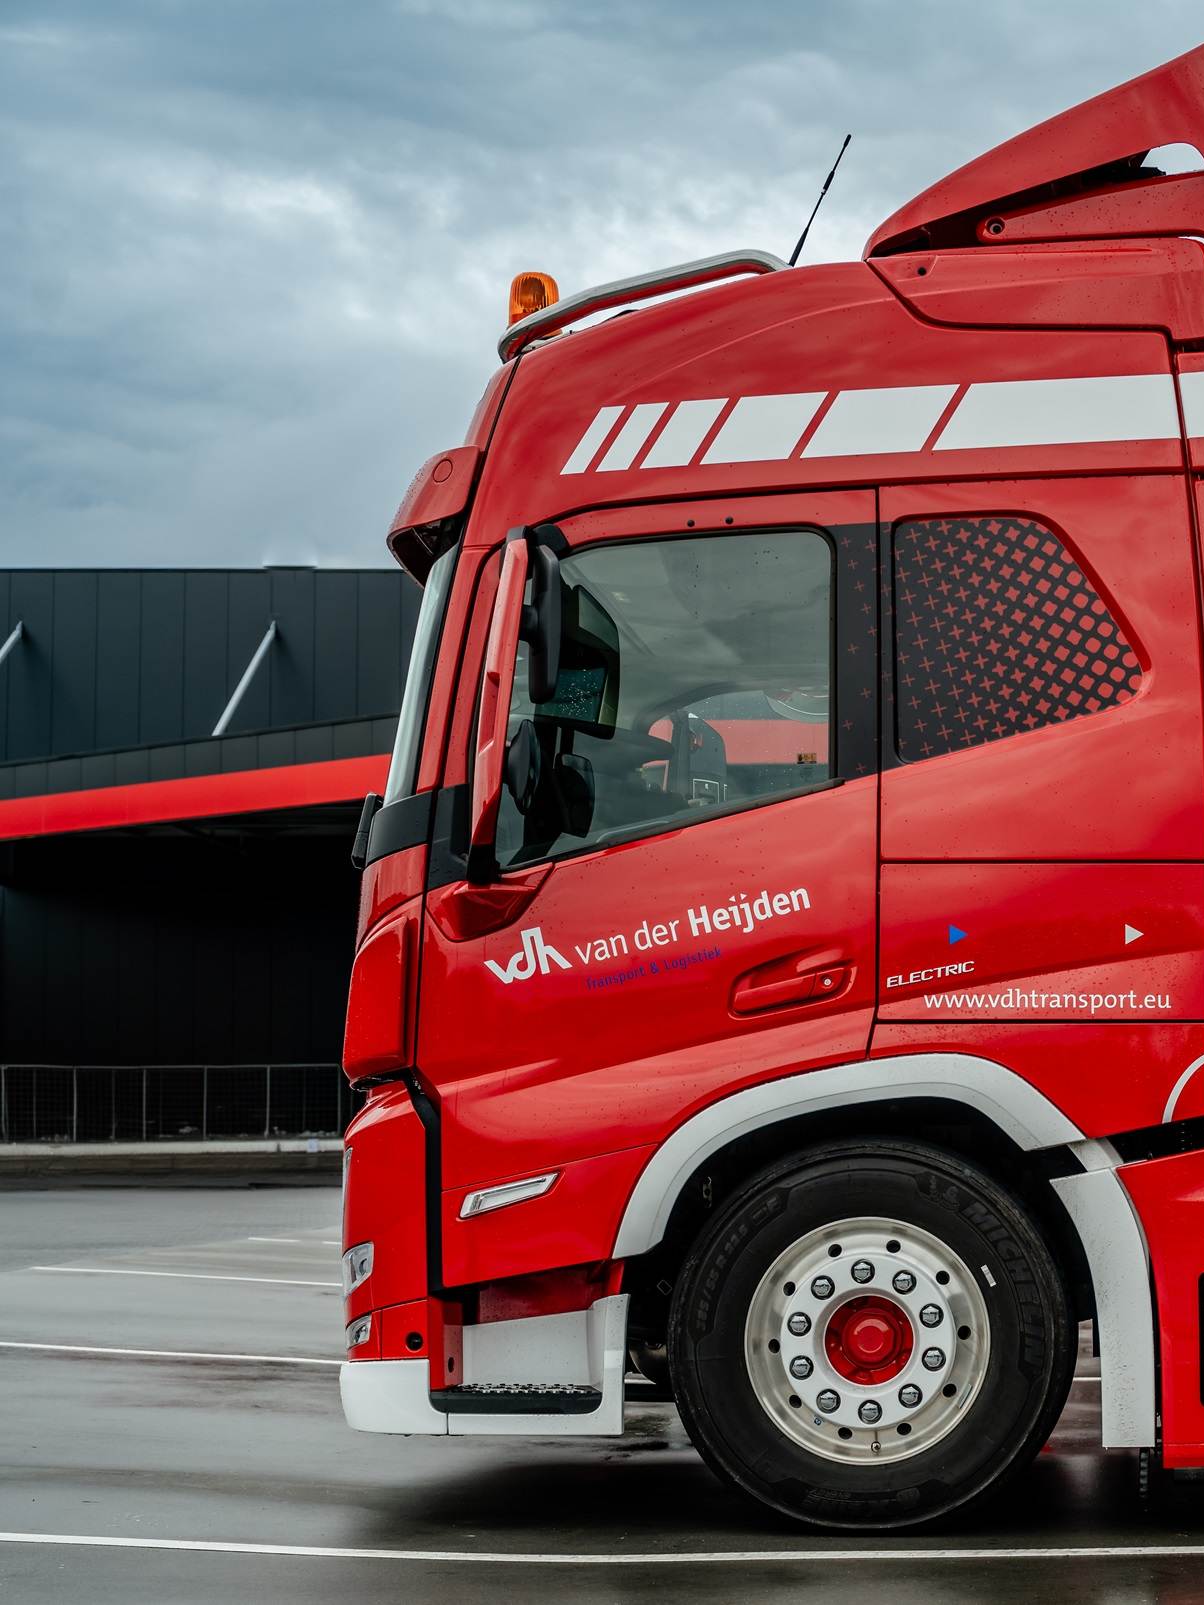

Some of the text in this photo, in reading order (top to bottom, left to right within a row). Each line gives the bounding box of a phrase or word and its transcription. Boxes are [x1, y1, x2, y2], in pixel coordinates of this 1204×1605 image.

[574, 887, 811, 965] van der Heijden
[586, 947, 721, 991] Transport & Logistiek
[886, 961, 975, 988] ELECTRIC
[924, 989, 1171, 1013] www.vdhtransport.eu
[961, 1200, 1046, 1366] MICHELIN
